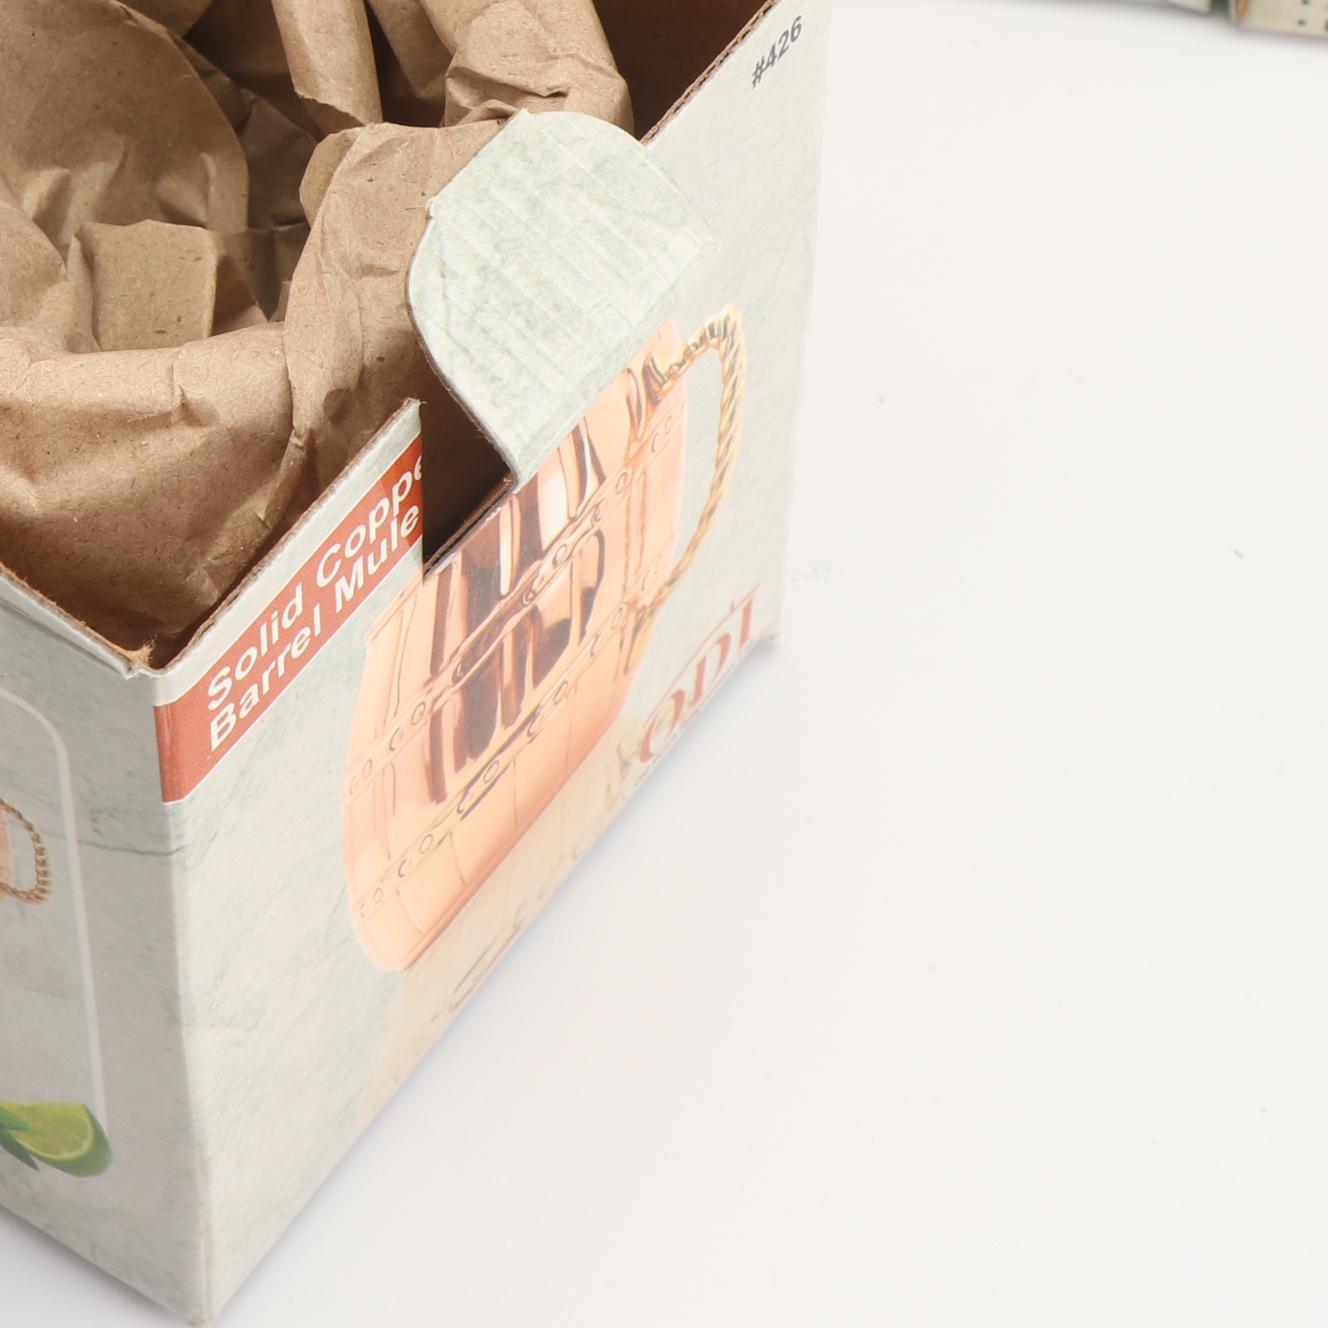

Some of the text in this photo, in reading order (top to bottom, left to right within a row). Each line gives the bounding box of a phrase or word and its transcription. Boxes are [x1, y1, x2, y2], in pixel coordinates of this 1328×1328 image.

[751, 15, 802, 89] #426
[207, 581, 304, 712] Solid
[211, 504, 420, 752] Barrel Mule
